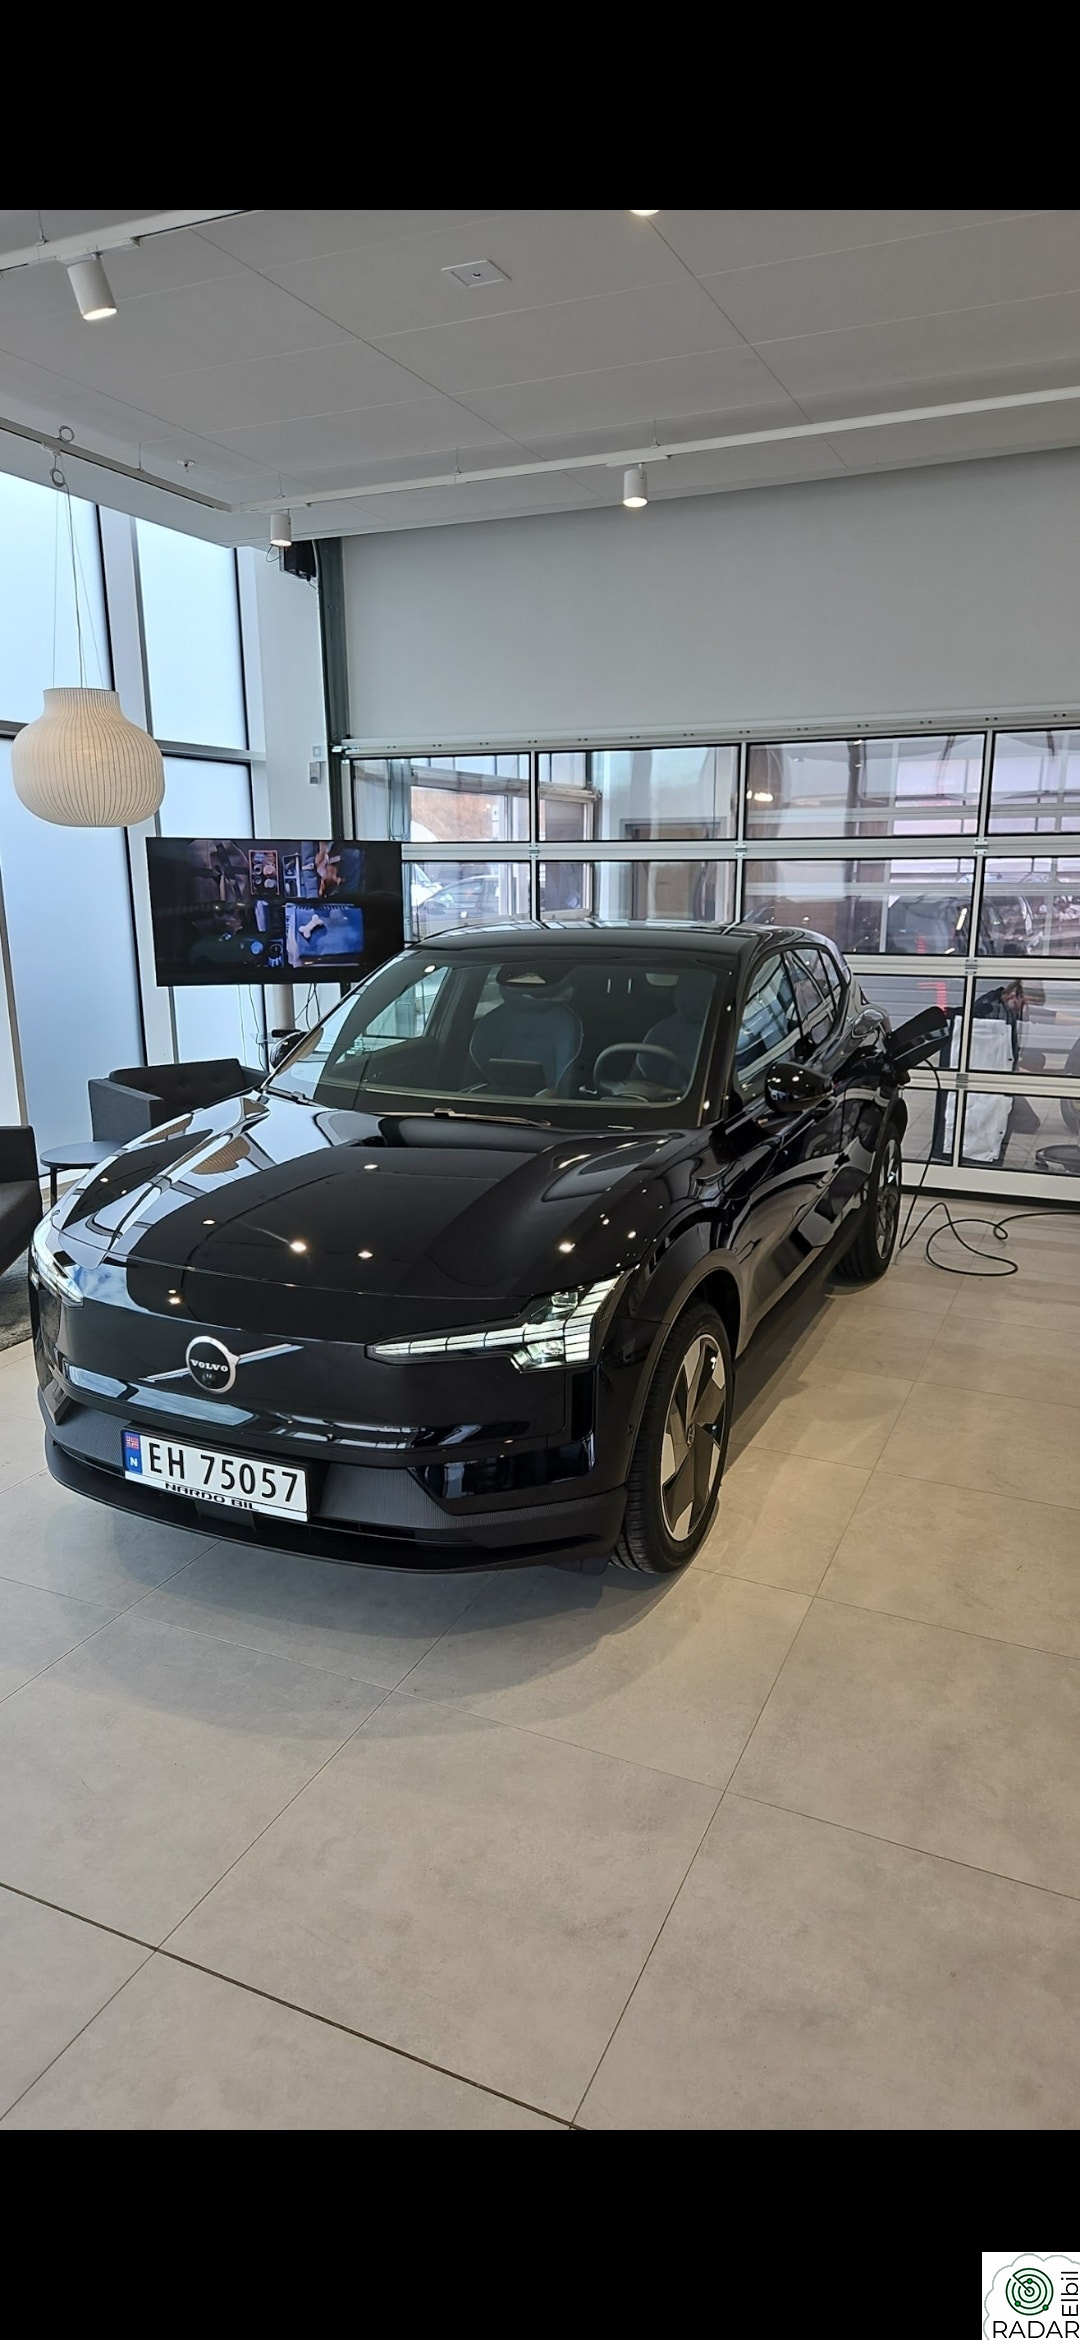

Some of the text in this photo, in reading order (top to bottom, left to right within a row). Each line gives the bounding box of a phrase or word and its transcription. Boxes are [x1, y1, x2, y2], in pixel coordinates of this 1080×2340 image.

[190, 1359, 228, 1372] VOLVO
[130, 1457, 138, 1467] N
[149, 1443, 298, 1502] EH 75057
[165, 1482, 260, 1511] NARDO BIL
